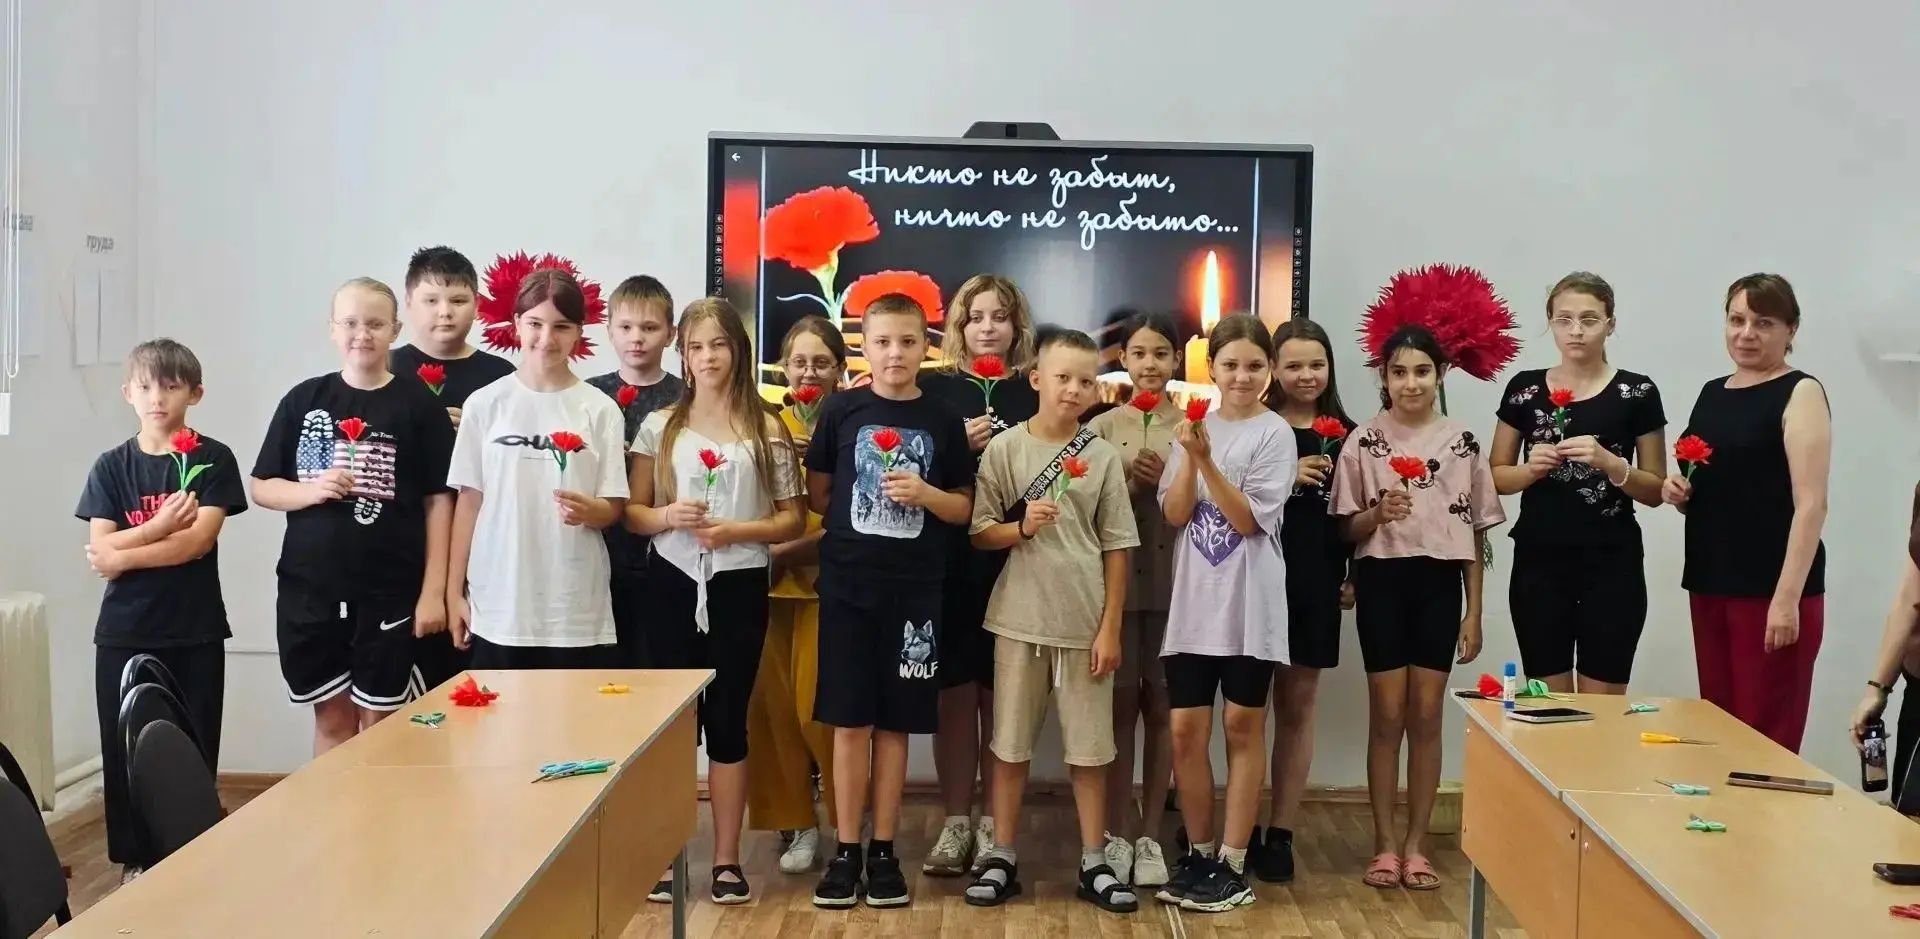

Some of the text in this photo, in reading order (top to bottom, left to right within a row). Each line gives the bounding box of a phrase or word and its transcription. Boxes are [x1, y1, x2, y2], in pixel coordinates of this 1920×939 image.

[848, 149, 1176, 208] Никто не забыт,
[895, 192, 1239, 250] ничто не забыто...
[899, 660, 938, 680] WOLF
